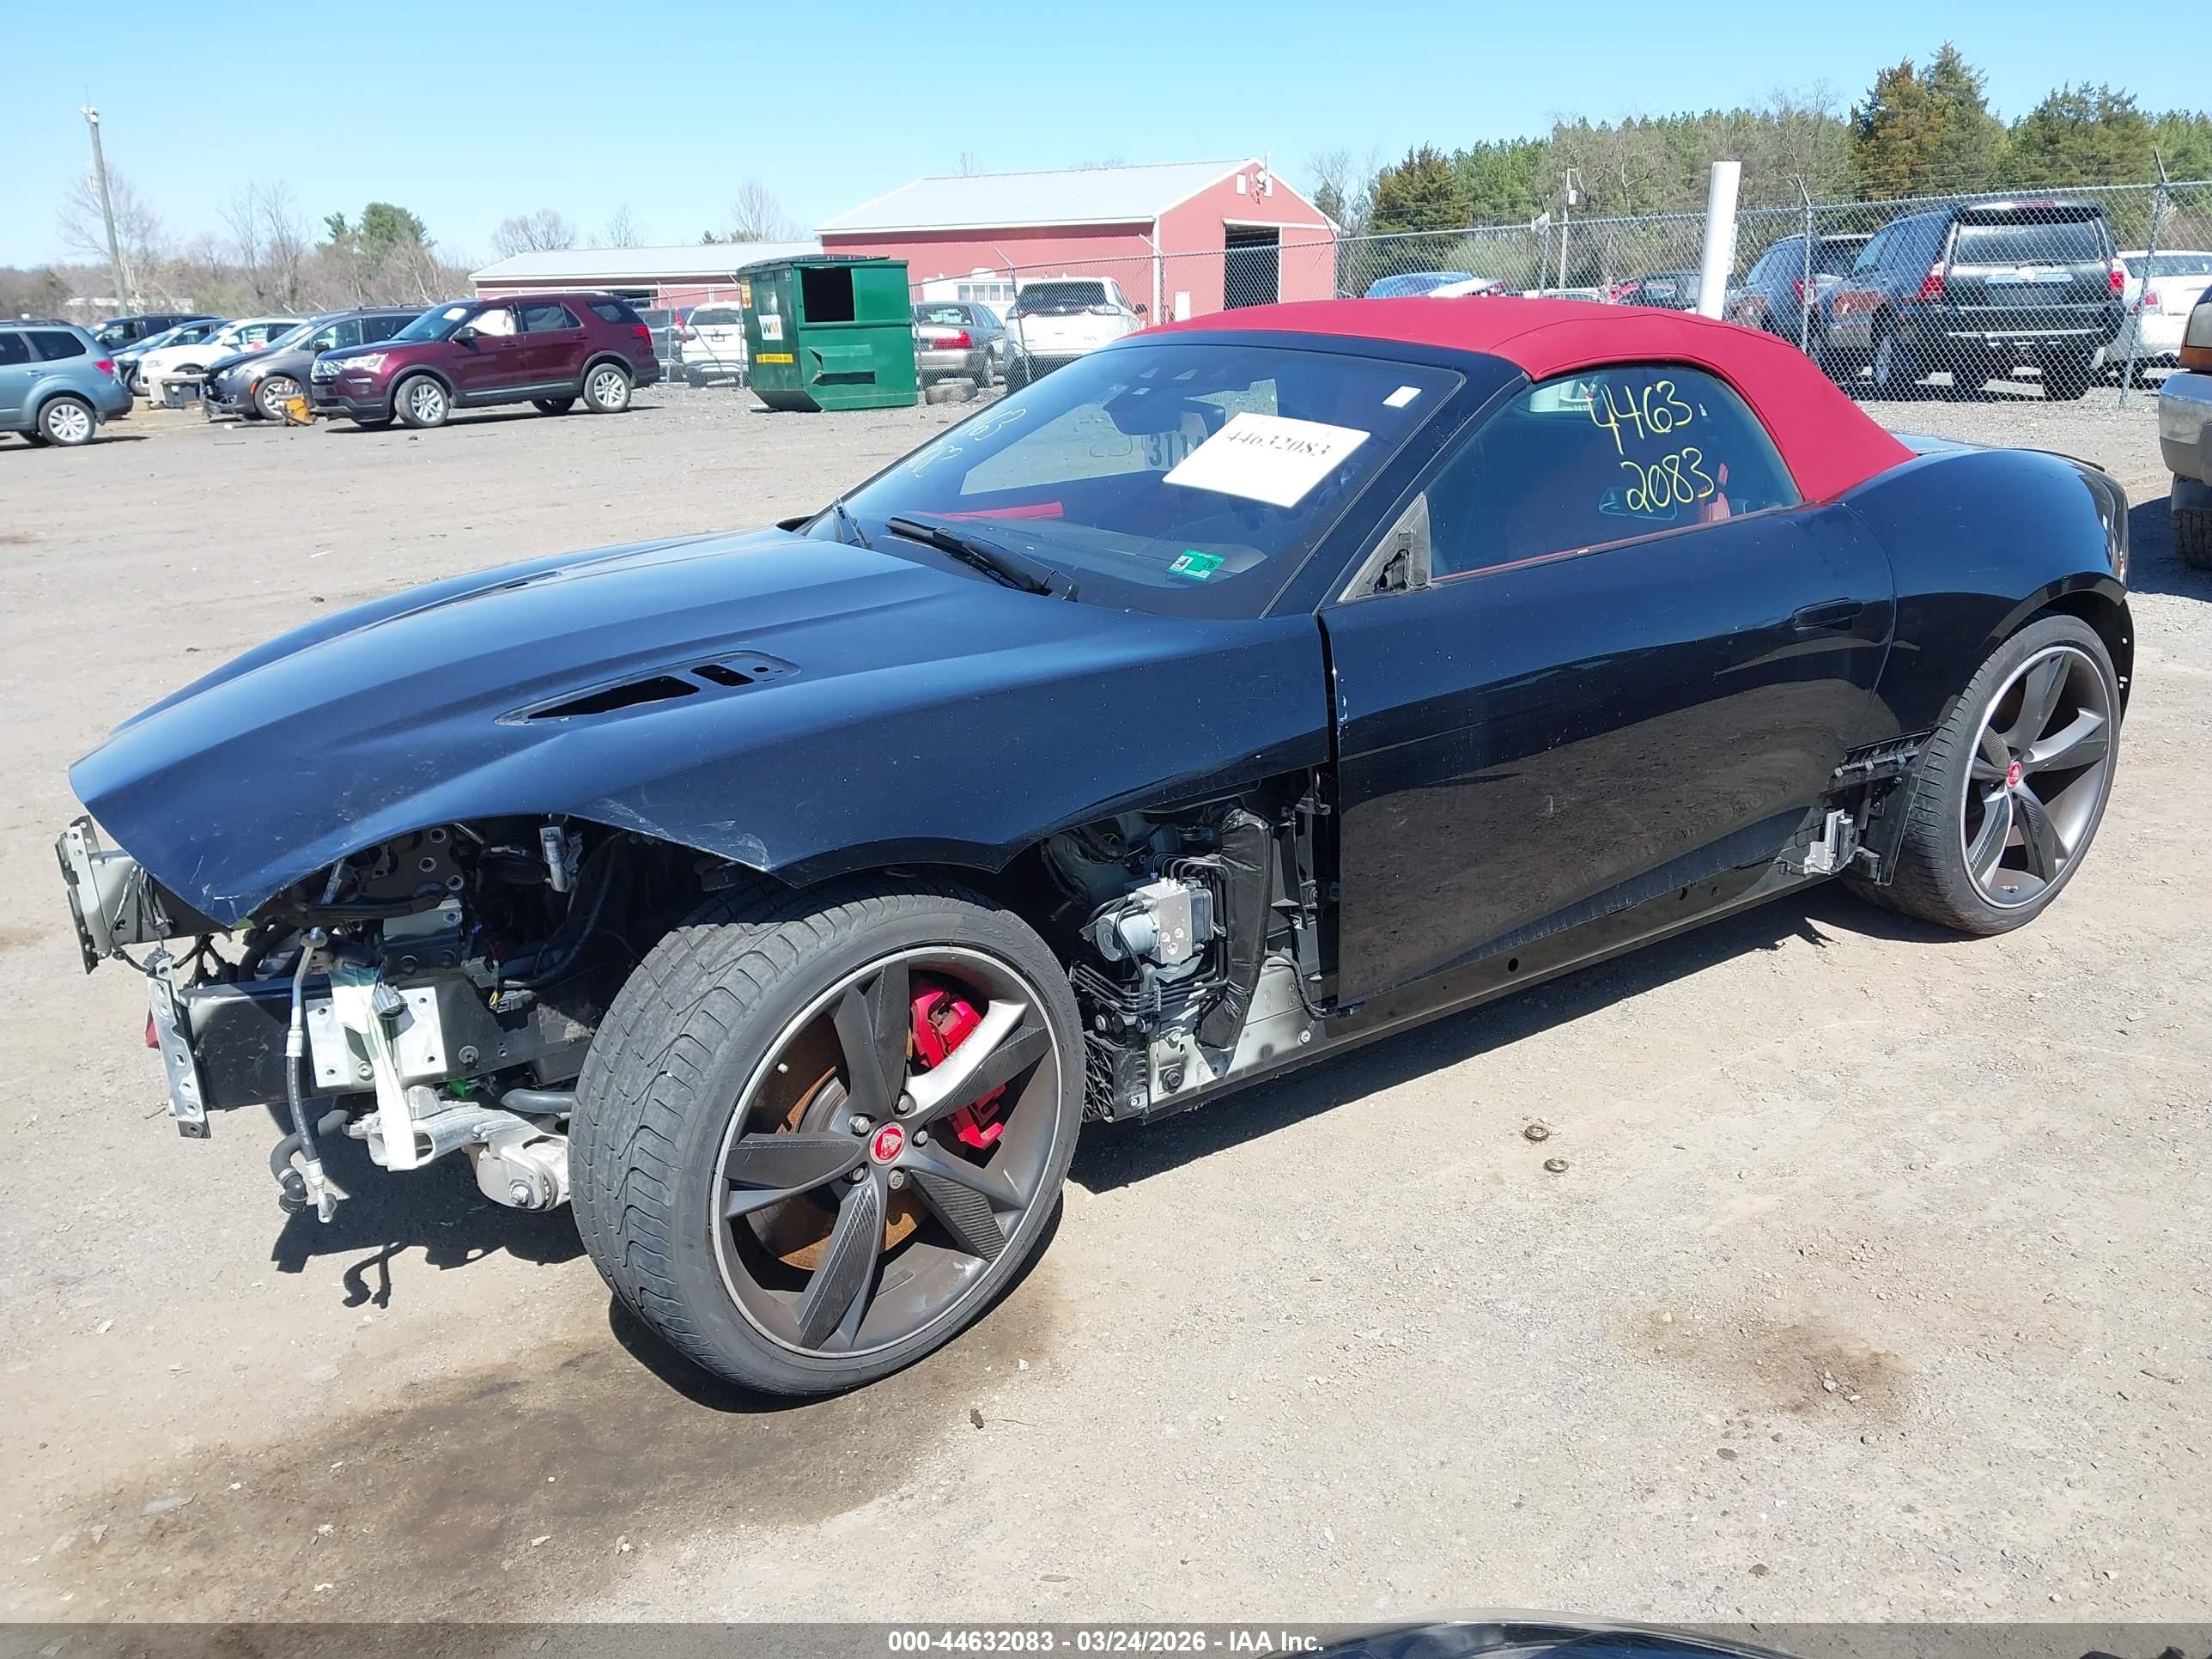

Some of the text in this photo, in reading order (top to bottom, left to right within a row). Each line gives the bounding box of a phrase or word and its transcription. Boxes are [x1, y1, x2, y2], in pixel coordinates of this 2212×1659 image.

[1581, 380, 1692, 455] 4463
[1226, 431, 1332, 456] 44632083
[1620, 447, 1715, 514] 2083
[1202, 559, 1218, 568] 26
